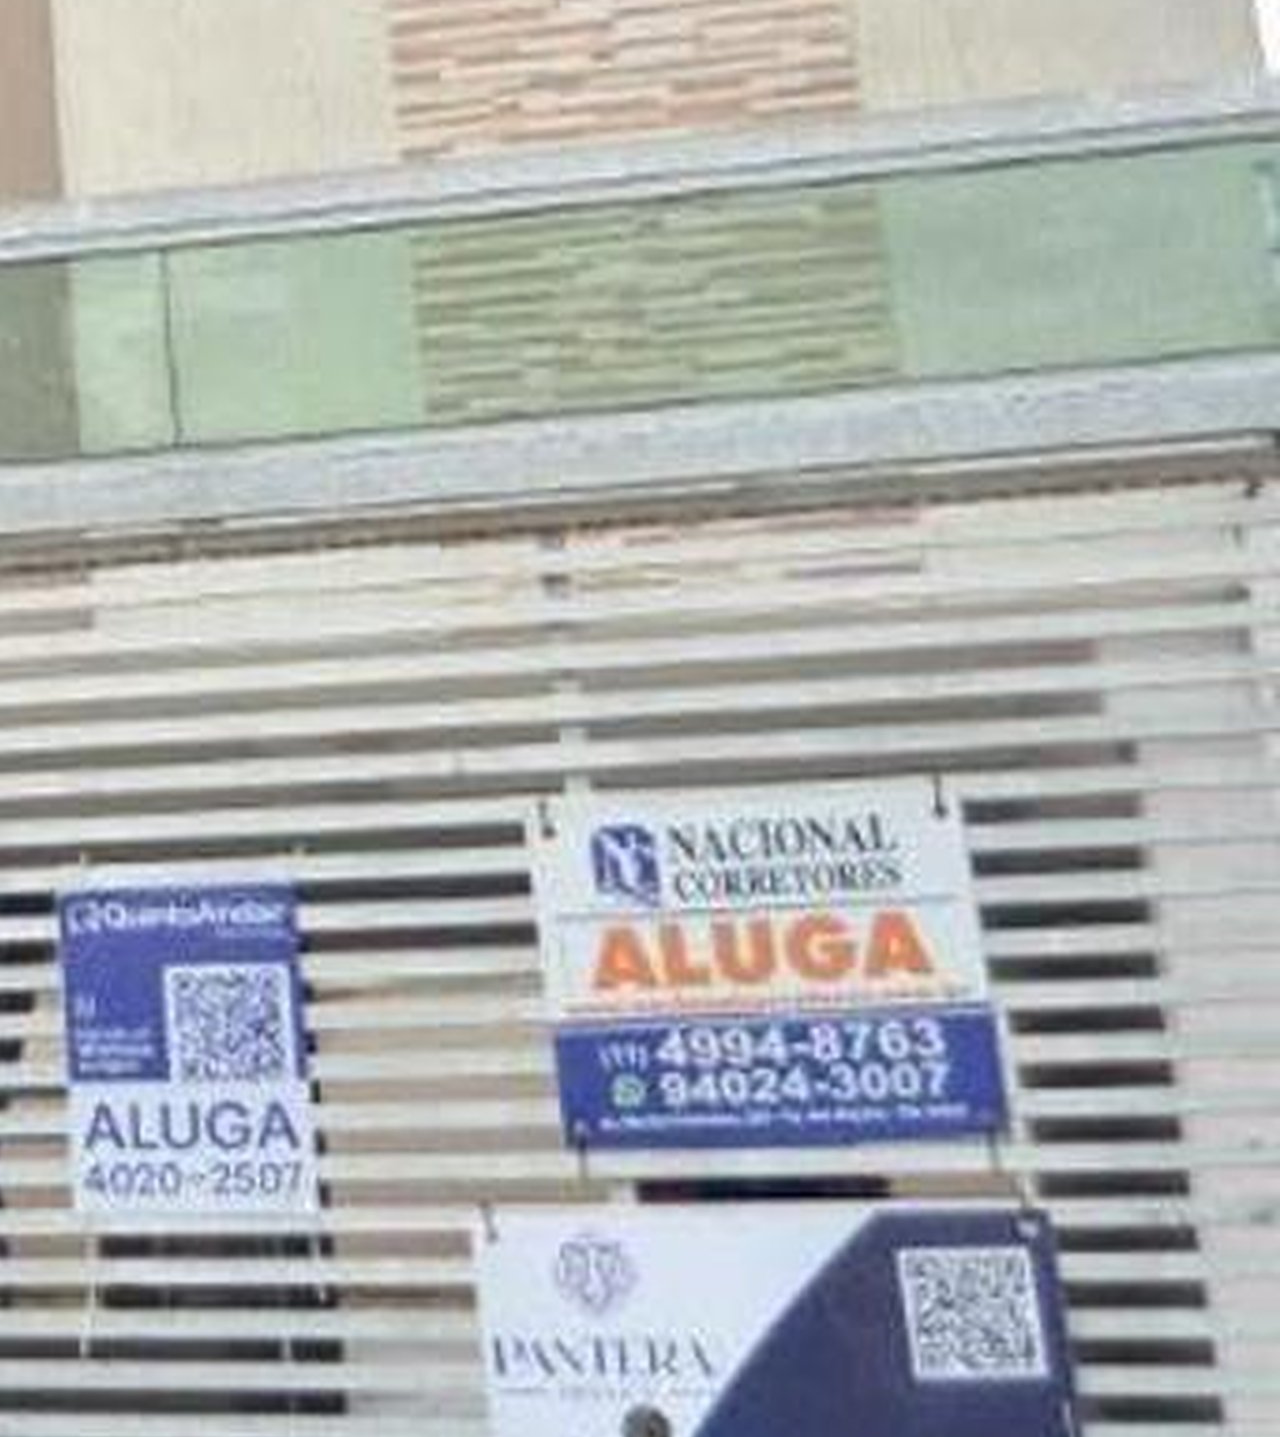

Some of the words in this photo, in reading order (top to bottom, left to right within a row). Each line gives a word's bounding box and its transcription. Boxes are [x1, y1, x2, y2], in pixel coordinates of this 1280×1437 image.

[668, 813, 898, 862] NACIONAL
[674, 859, 904, 902] CORRETORES
[592, 910, 936, 990] ALUGA
[655, 1019, 947, 1066] 4994-8763
[659, 1061, 952, 1108] 94024-3007
[84, 1099, 300, 1151] ALUGA
[83, 1160, 303, 1196] 4020-2507
[493, 1334, 714, 1377] PANTERA
